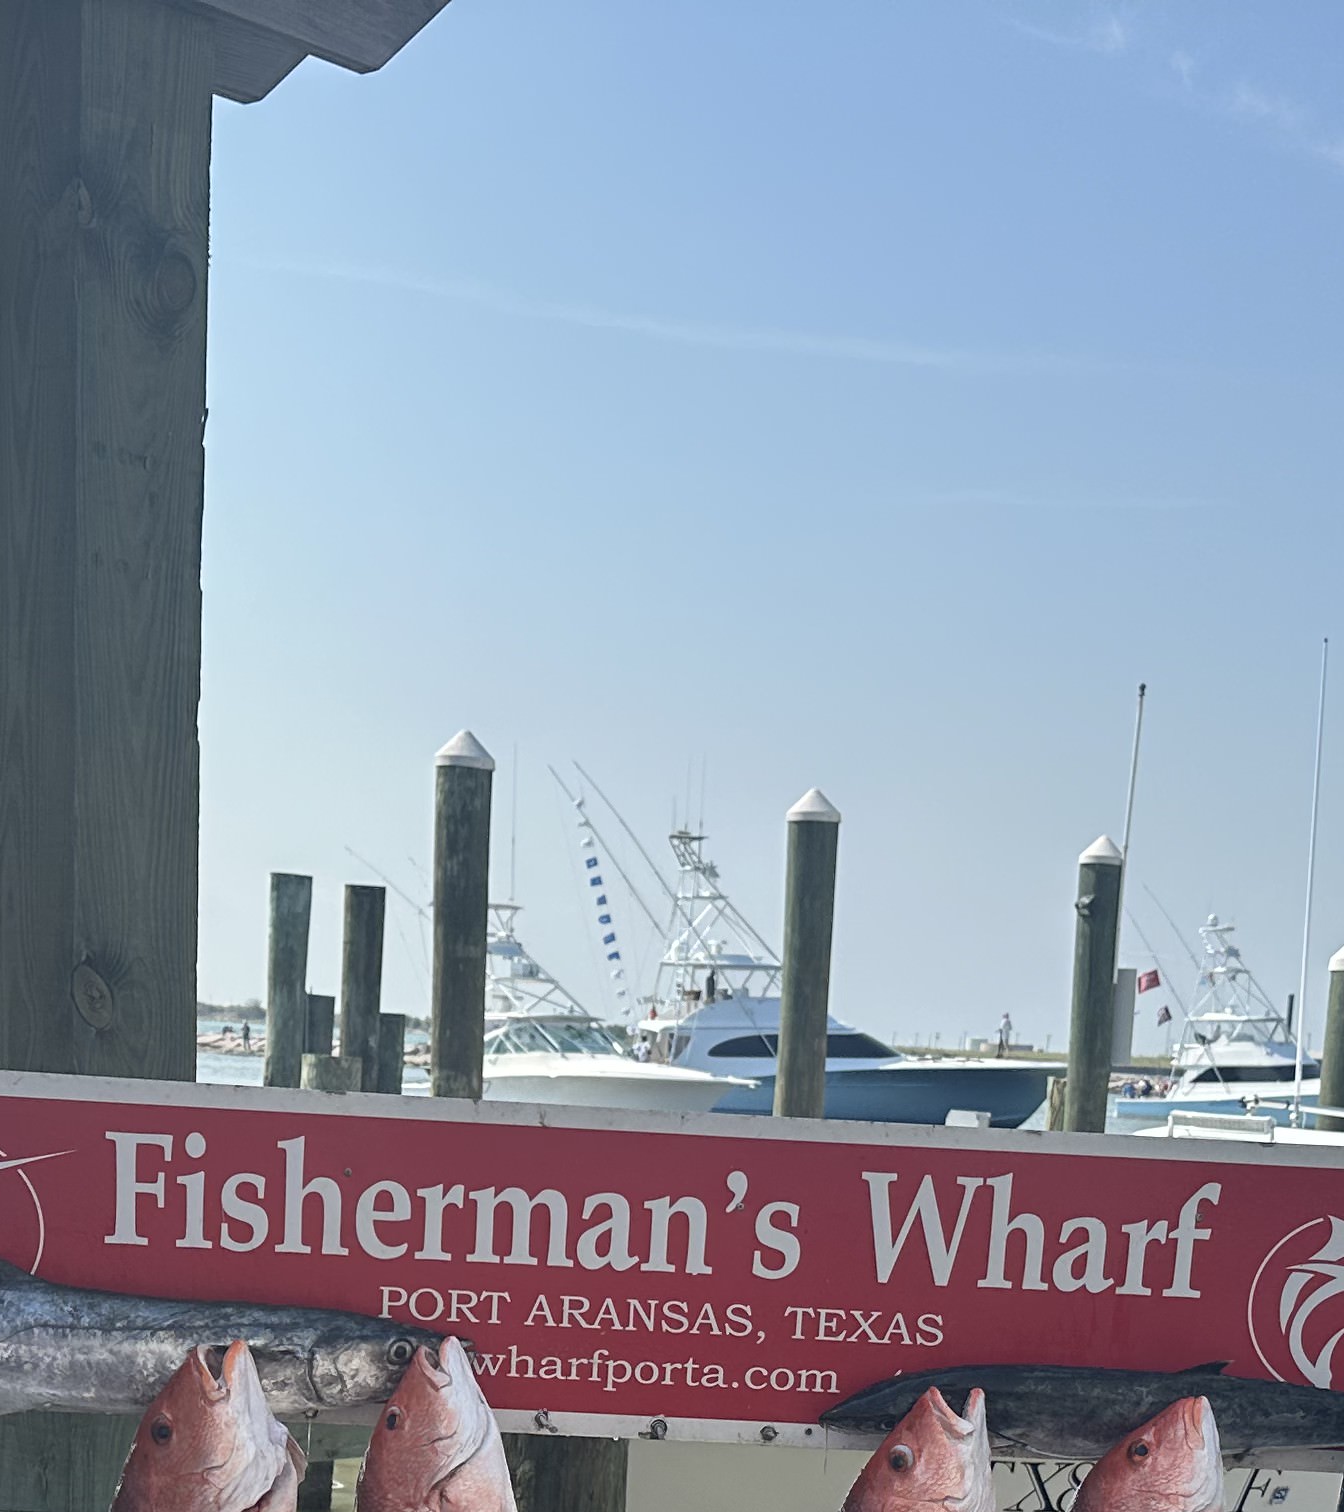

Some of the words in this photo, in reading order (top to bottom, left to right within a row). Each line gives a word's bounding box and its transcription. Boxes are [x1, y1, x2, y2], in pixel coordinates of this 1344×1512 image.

[860, 1171, 1223, 1299] Wharf
[377, 1285, 512, 1325] PORT
[523, 1293, 767, 1345] ARANSAS,
[783, 1305, 945, 1348] TEXAS
